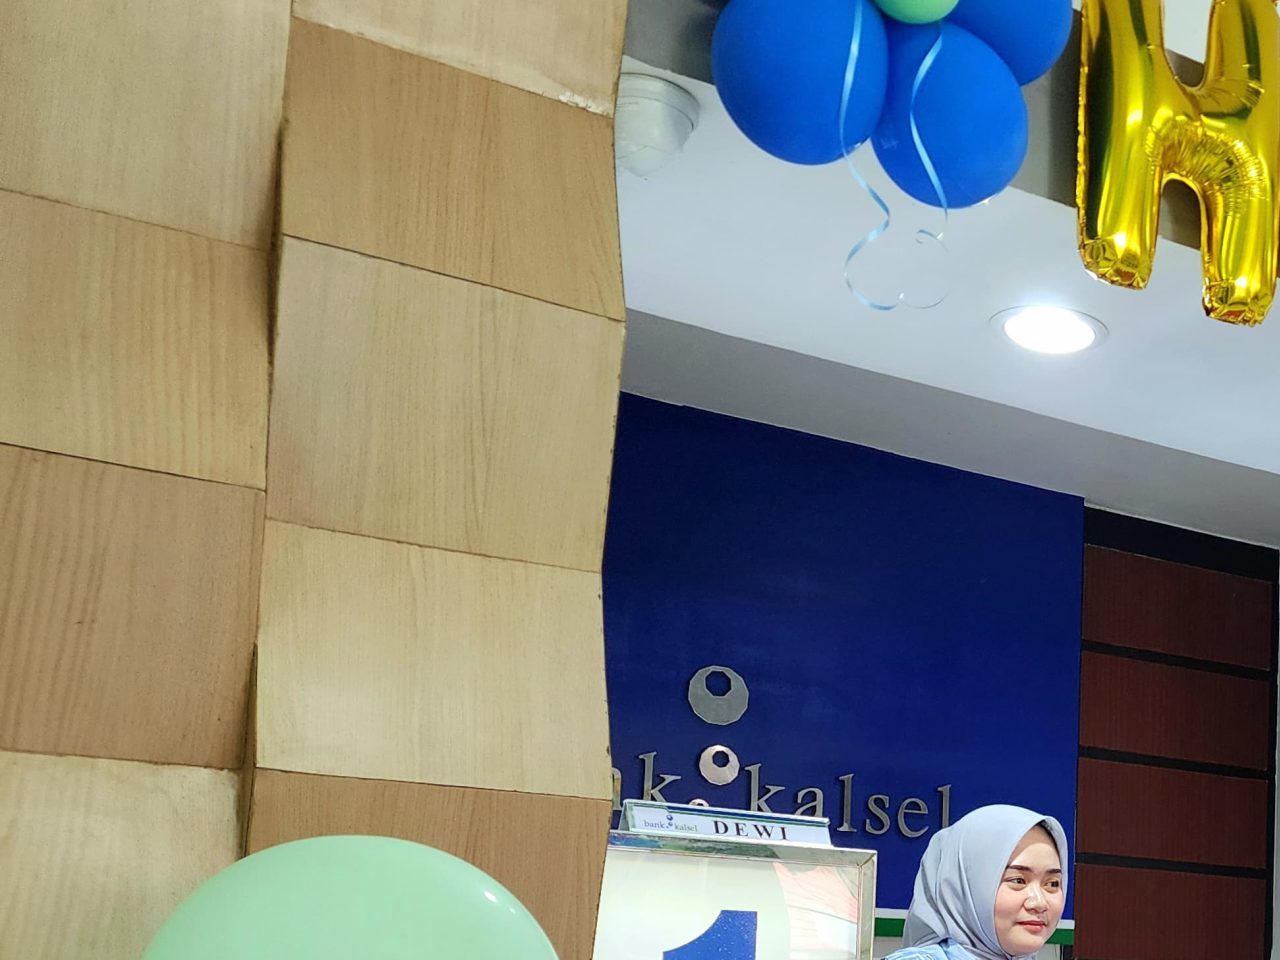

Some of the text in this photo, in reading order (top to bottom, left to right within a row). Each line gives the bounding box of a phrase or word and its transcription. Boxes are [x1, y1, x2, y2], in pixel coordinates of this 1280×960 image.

[643, 819, 788, 841] bank kalsel DEWI
